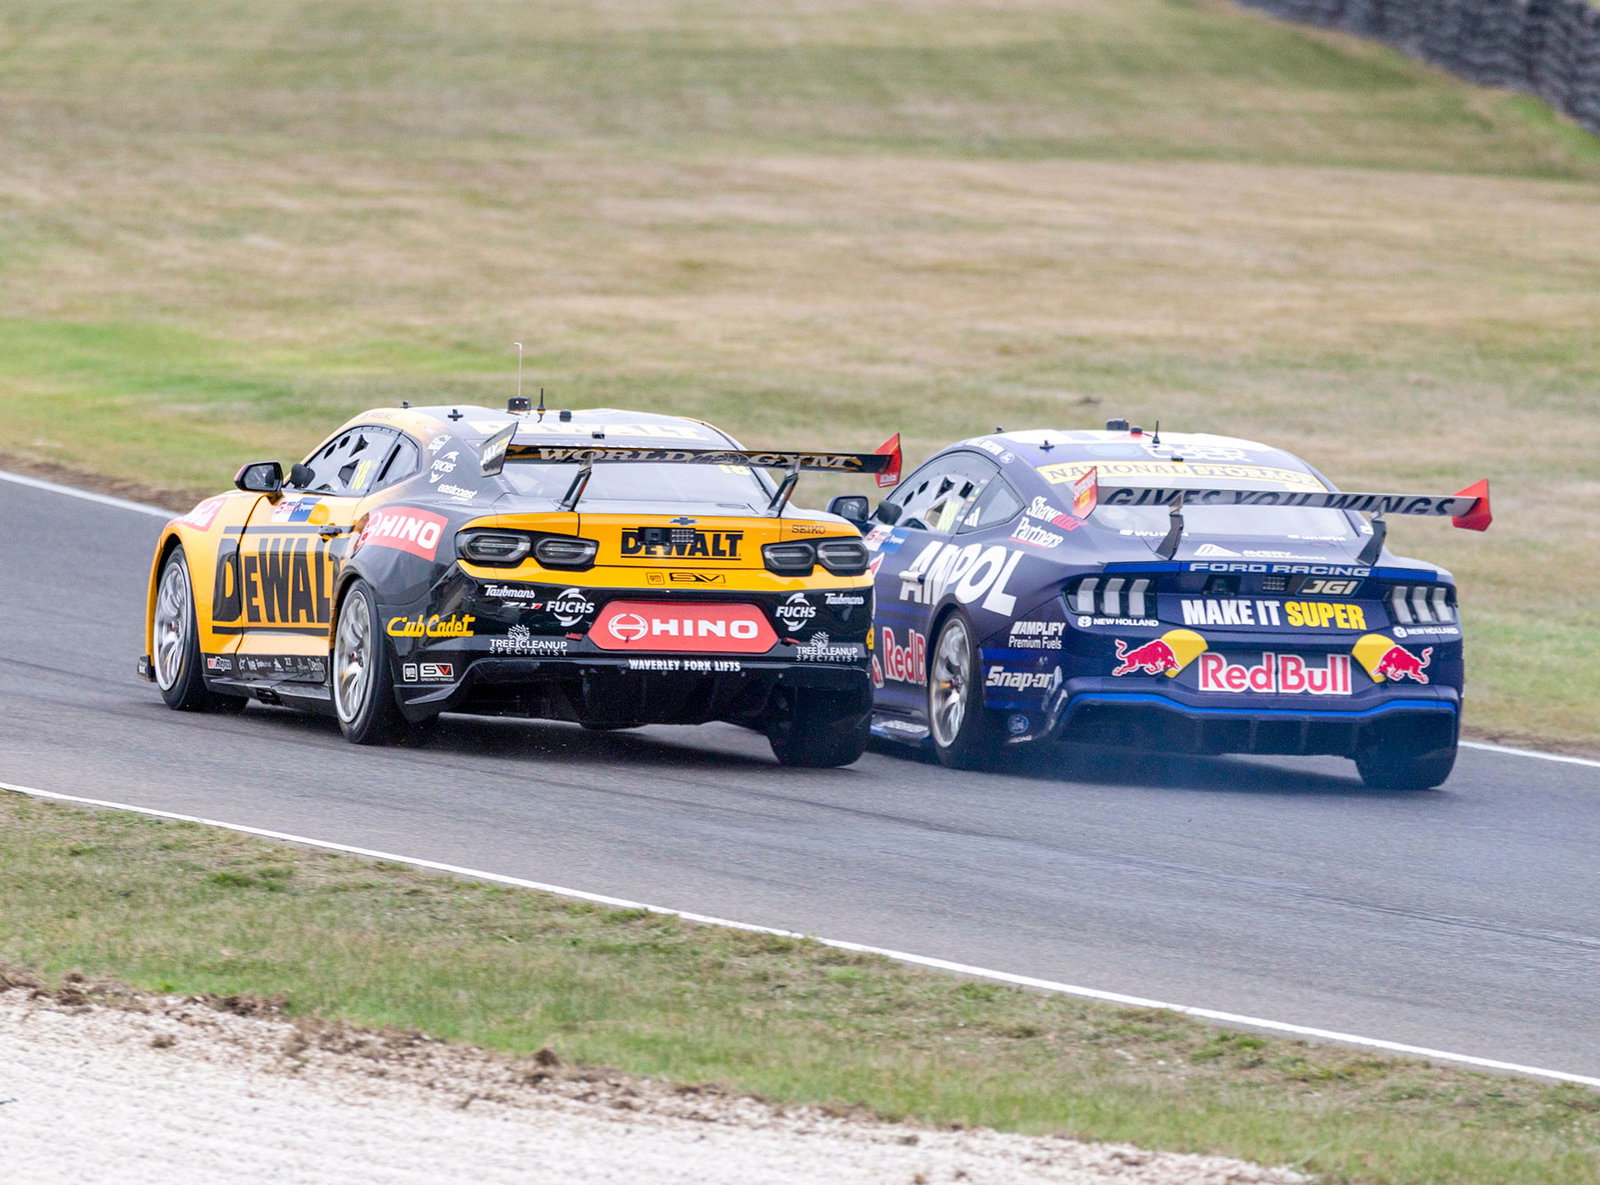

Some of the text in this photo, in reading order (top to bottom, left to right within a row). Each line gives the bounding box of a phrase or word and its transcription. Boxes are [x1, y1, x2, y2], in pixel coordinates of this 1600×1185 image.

[430, 459, 456, 473] FUCHS
[538, 448, 849, 469] WORLD GYM
[1104, 488, 1455, 516] GIVES YOU WINGS
[1026, 496, 1061, 524] Shaw
[374, 514, 441, 550] HINO
[792, 525, 826, 535] SEIKO
[1009, 517, 1064, 549] Partners
[1189, 562, 1372, 578] FORD RACING
[484, 584, 536, 599] Taubmans
[1301, 580, 1357, 595] JGI
[545, 600, 595, 614] FUCHS
[775, 606, 817, 618] FUCHS
[1093, 617, 1159, 627] NEW HOLLAND
[1181, 600, 1368, 630] MAKE IT SUPER
[387, 614, 476, 637] Cub Cadet
[651, 618, 759, 639] HINO
[1019, 621, 1066, 636] AMPLIFY
[490, 638, 568, 650] TREE CLEANUP
[1009, 635, 1063, 650] Premium Fuels
[490, 647, 568, 656] SPECIALIST
[796, 646, 858, 656] TREE CLEANUP
[629, 659, 741, 672] WAVERLEY FORK LIFTS
[986, 665, 1055, 692] Snap-on
[1199, 652, 1353, 695] Red Bull
